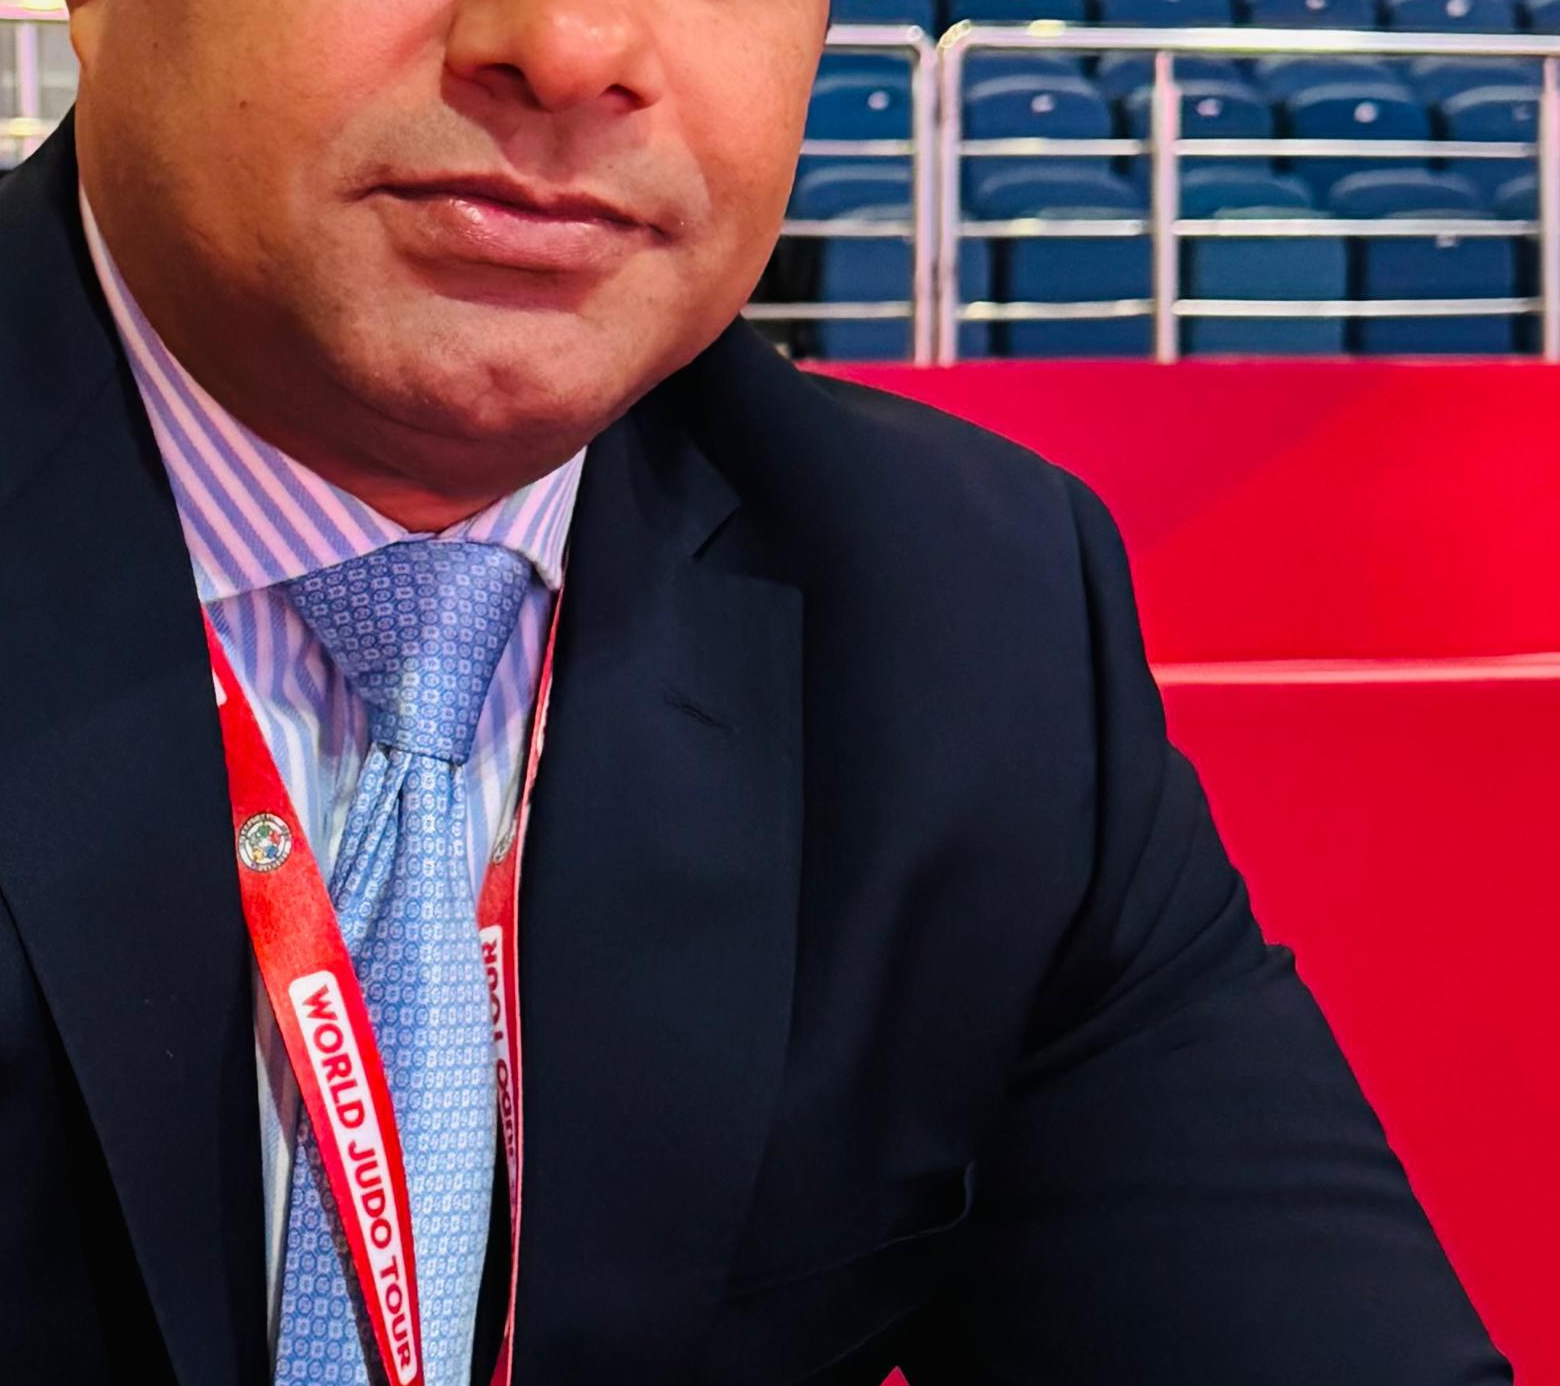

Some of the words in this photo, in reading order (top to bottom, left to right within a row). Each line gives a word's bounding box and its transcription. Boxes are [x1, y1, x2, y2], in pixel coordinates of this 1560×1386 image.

[302, 984, 365, 1129] WORLD
[348, 1139, 392, 1249] JUDO
[380, 1255, 412, 1367] TOUR
